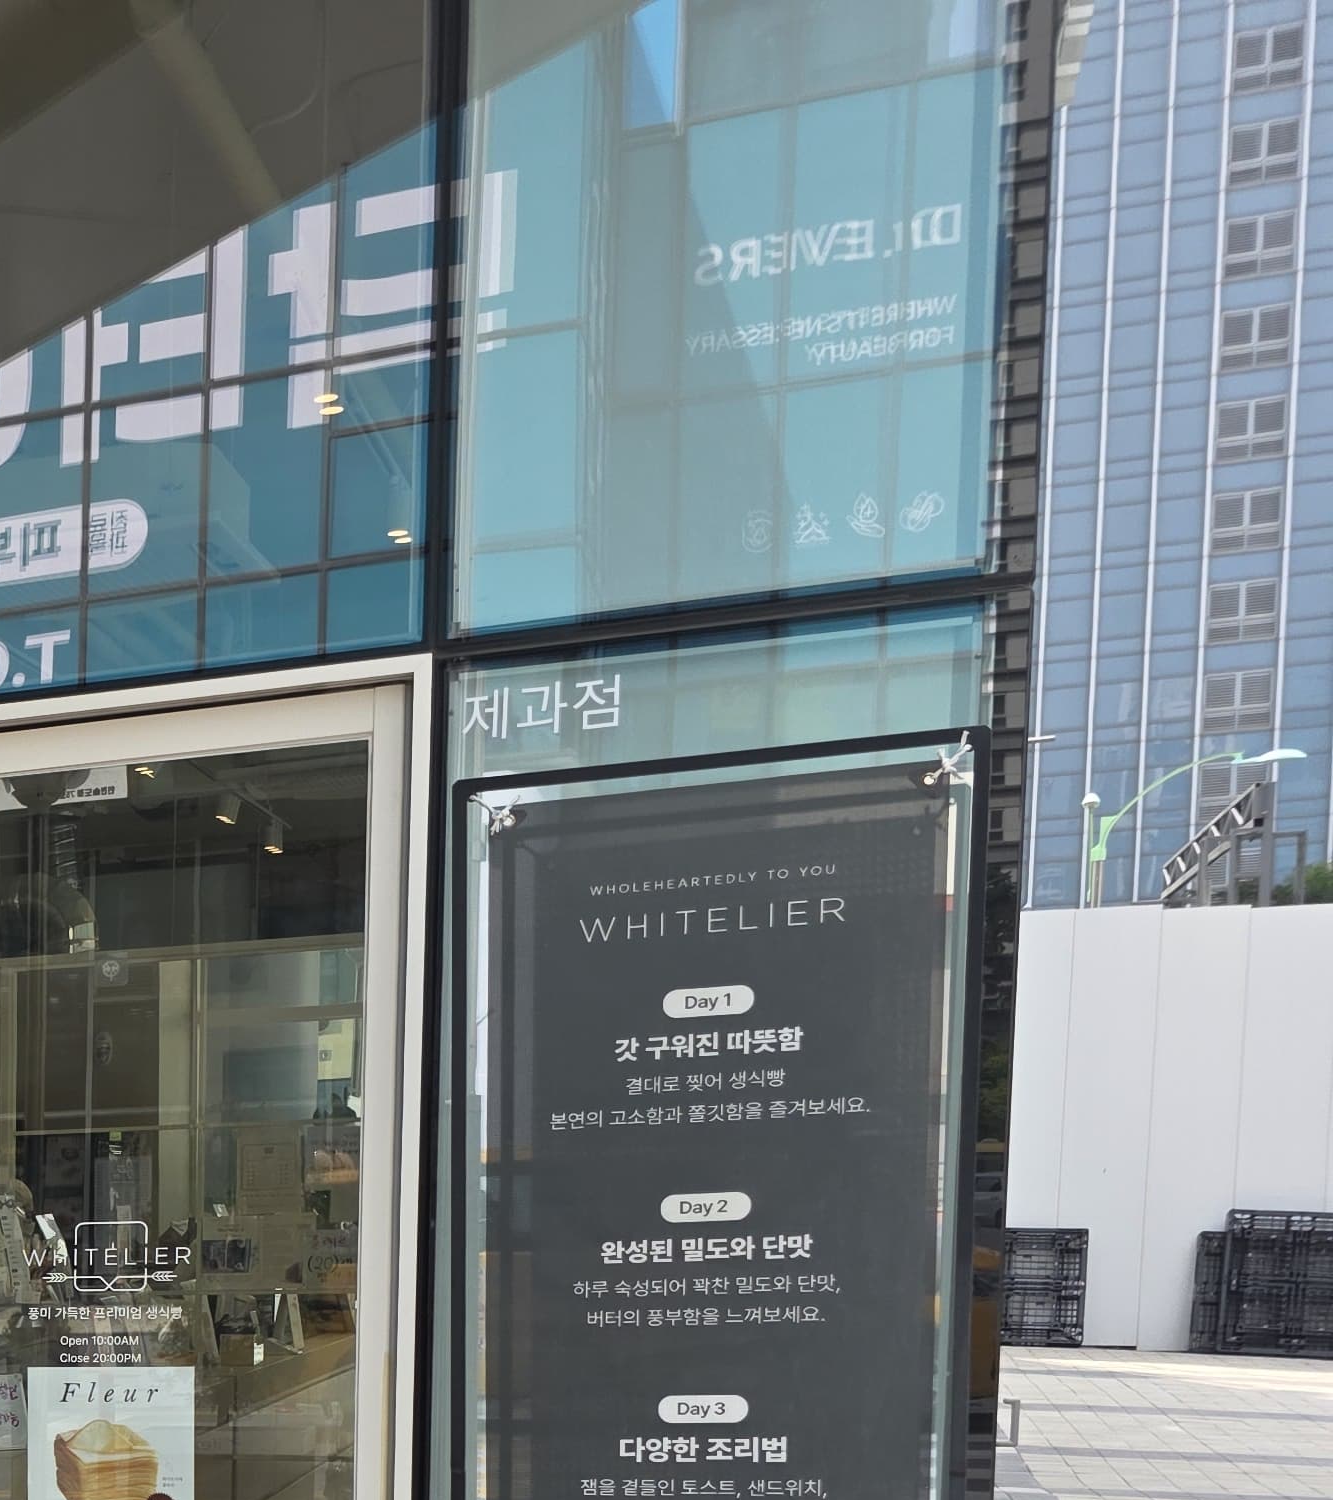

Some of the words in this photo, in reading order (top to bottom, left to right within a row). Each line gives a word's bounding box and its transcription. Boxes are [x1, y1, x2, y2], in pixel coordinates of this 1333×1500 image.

[460, 671, 624, 742] 제과점
[589, 870, 757, 896] WHOLEHEARTEDLY
[767, 868, 789, 880] TO
[799, 864, 836, 877] YOU
[579, 897, 846, 943] WHITELIER
[684, 993, 720, 1012] Day
[723, 992, 733, 1007] 1
[614, 1037, 640, 1061] 갓
[644, 1033, 720, 1060] 구워진
[727, 1026, 804, 1055] 따뜻함
[626, 1074, 681, 1096] 결대로
[686, 1072, 723, 1093] 찢어
[729, 1068, 786, 1089] 생식빵
[549, 1110, 603, 1132] 본연의
[608, 1105, 683, 1127] 고소함과
[688, 1101, 762, 1124] 쫄깃함을
[768, 1096, 871, 1119] 즐겨보세요.
[679, 1199, 714, 1217] Day
[716, 1199, 729, 1214] 2
[23, 1246, 191, 1267] WHITELIER
[600, 1239, 674, 1265] 완성된
[681, 1236, 756, 1262] 밀도와
[762, 1233, 813, 1260] 단맛
[573, 1279, 609, 1299] 하루
[614, 1277, 687, 1298] 숙성되어
[692, 1275, 730, 1296] 꽉찬
[735, 1275, 792, 1296] 밀도와
[797, 1274, 841, 1295] 단맛,
[28, 1307, 50, 1320] 풍미
[55, 1306, 90, 1320] 가득한
[94, 1306, 141, 1320] 프리미엄
[146, 1305, 182, 1320] 생식빵
[587, 1308, 641, 1328] 버터의
[646, 1306, 720, 1327] 풍부함을
[725, 1304, 826, 1326] 느껴보세요.
[60, 1336, 89, 1348] Open
[92, 1335, 139, 1346] 10:00AM
[60, 1353, 90, 1364] Close
[93, 1353, 141, 1363] 20:00PM
[59, 1381, 160, 1405] Fleur
[677, 1402, 710, 1418] Day
[712, 1402, 726, 1416] 3
[619, 1437, 699, 1464] 다양한
[705, 1436, 788, 1464] 조리법
[580, 1478, 616, 1497] 잼을
[620, 1478, 675, 1497] 곁들인
[680, 1478, 742, 1499] 토스트,
[747, 1477, 828, 1500] 샌드위치,
